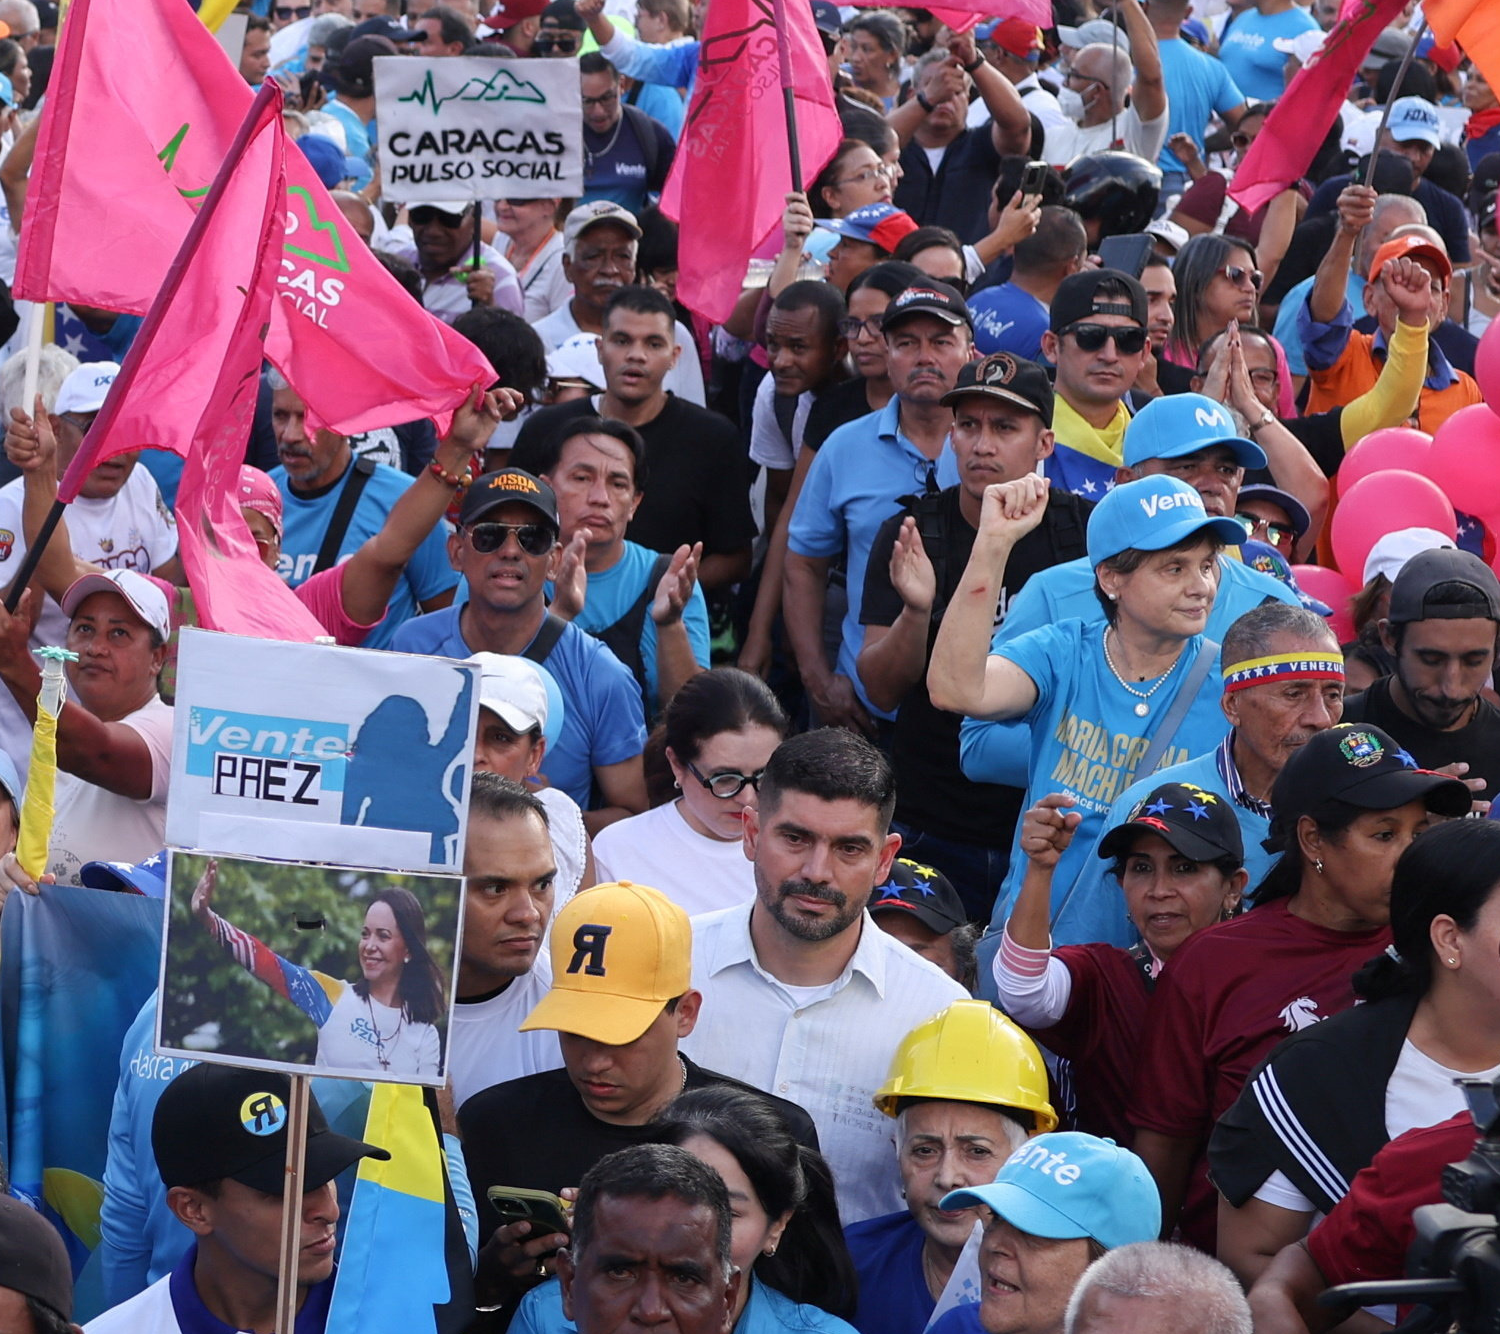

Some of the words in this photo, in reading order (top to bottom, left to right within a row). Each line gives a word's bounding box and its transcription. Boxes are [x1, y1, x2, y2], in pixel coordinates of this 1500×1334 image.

[389, 129, 566, 158] CARACAS
[390, 161, 474, 184] PULSO
[480, 159, 566, 183] SOCIAL
[190, 707, 347, 759] Vente
[215, 752, 321, 806] PAEZ
[1010, 1143, 1082, 1187] ente
